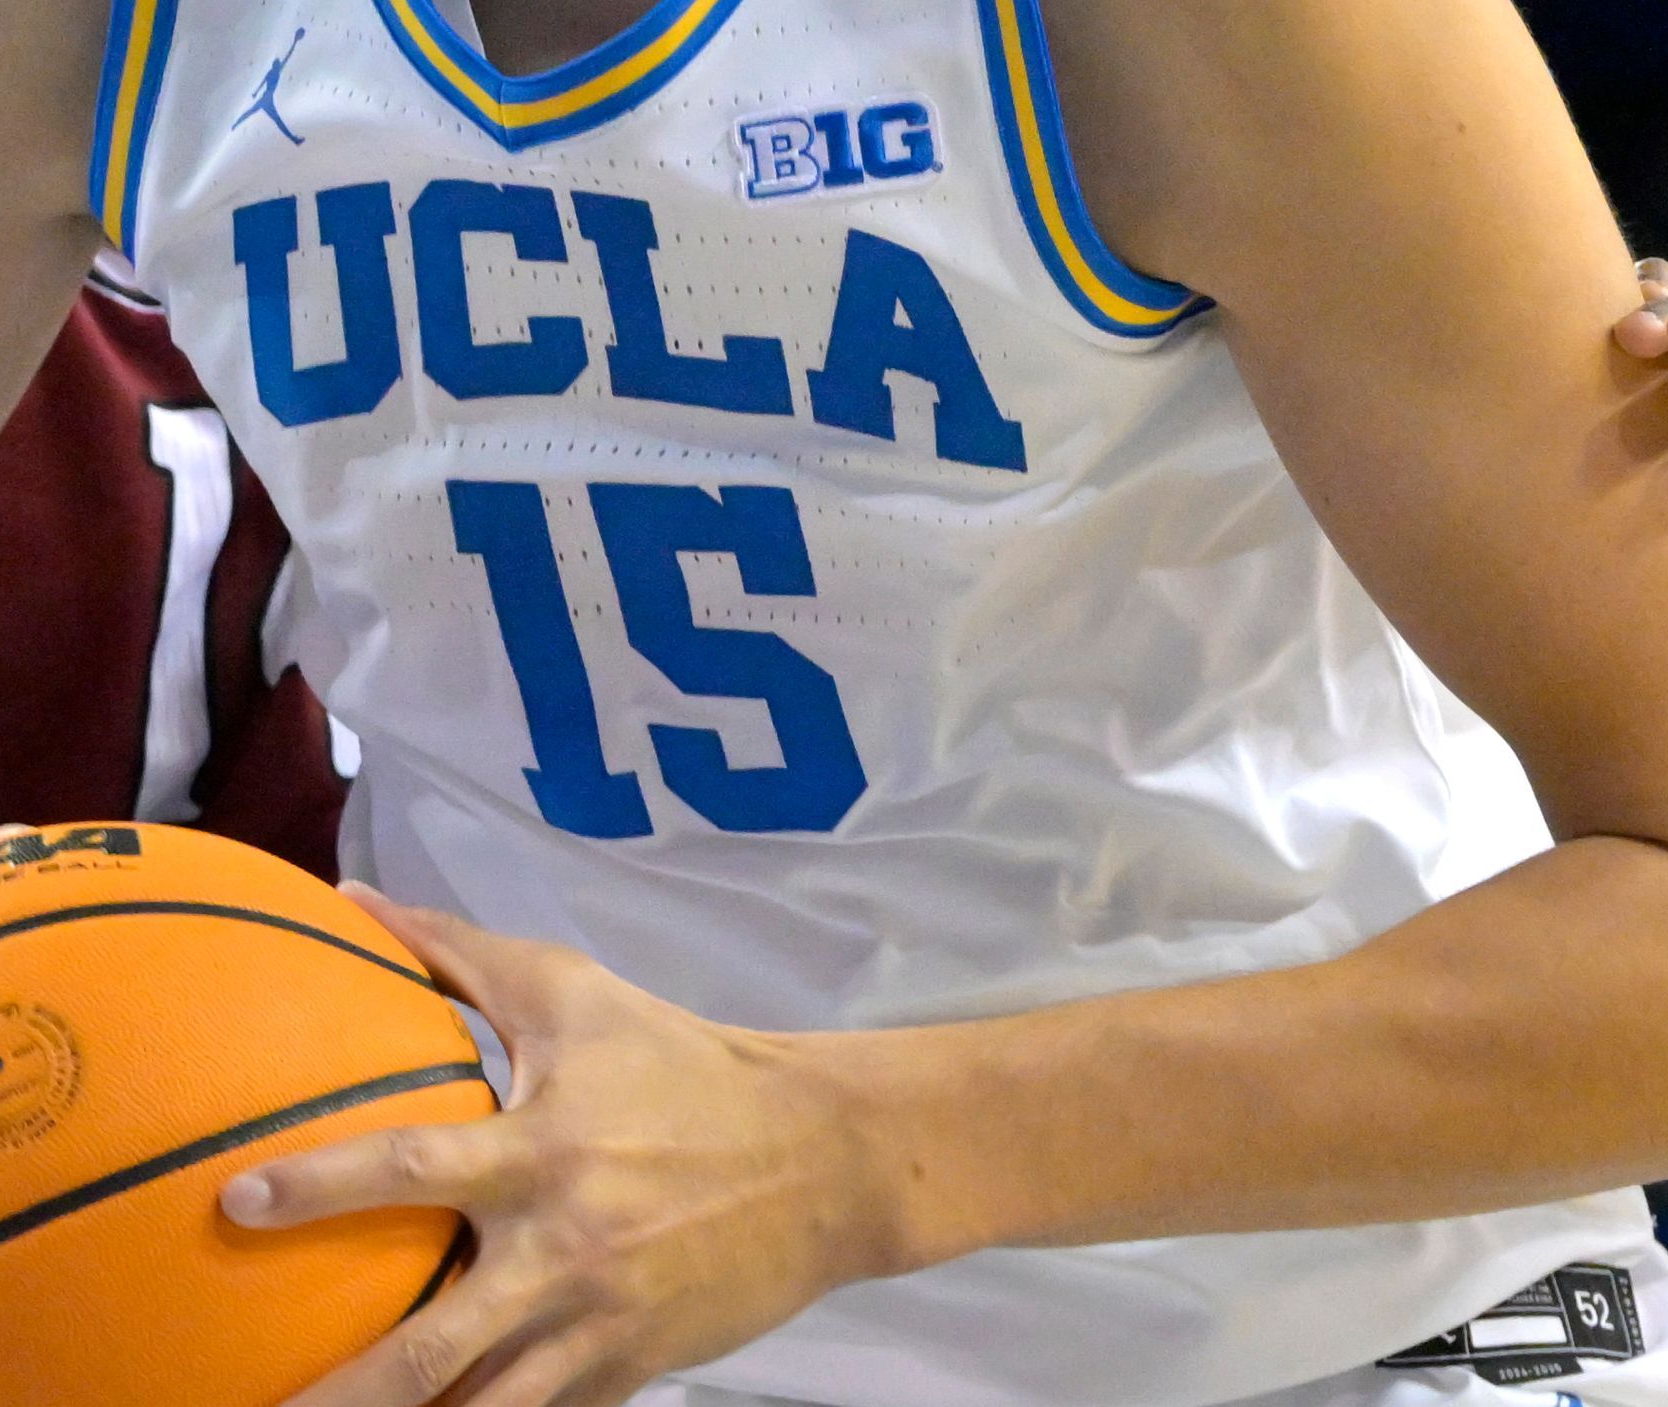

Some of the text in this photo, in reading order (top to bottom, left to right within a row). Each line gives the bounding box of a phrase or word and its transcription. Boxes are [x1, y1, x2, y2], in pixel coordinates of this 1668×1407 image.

[233, 178, 1027, 473] UCLA
[447, 479, 868, 839] 15
[1574, 1290, 1615, 1332] 52
